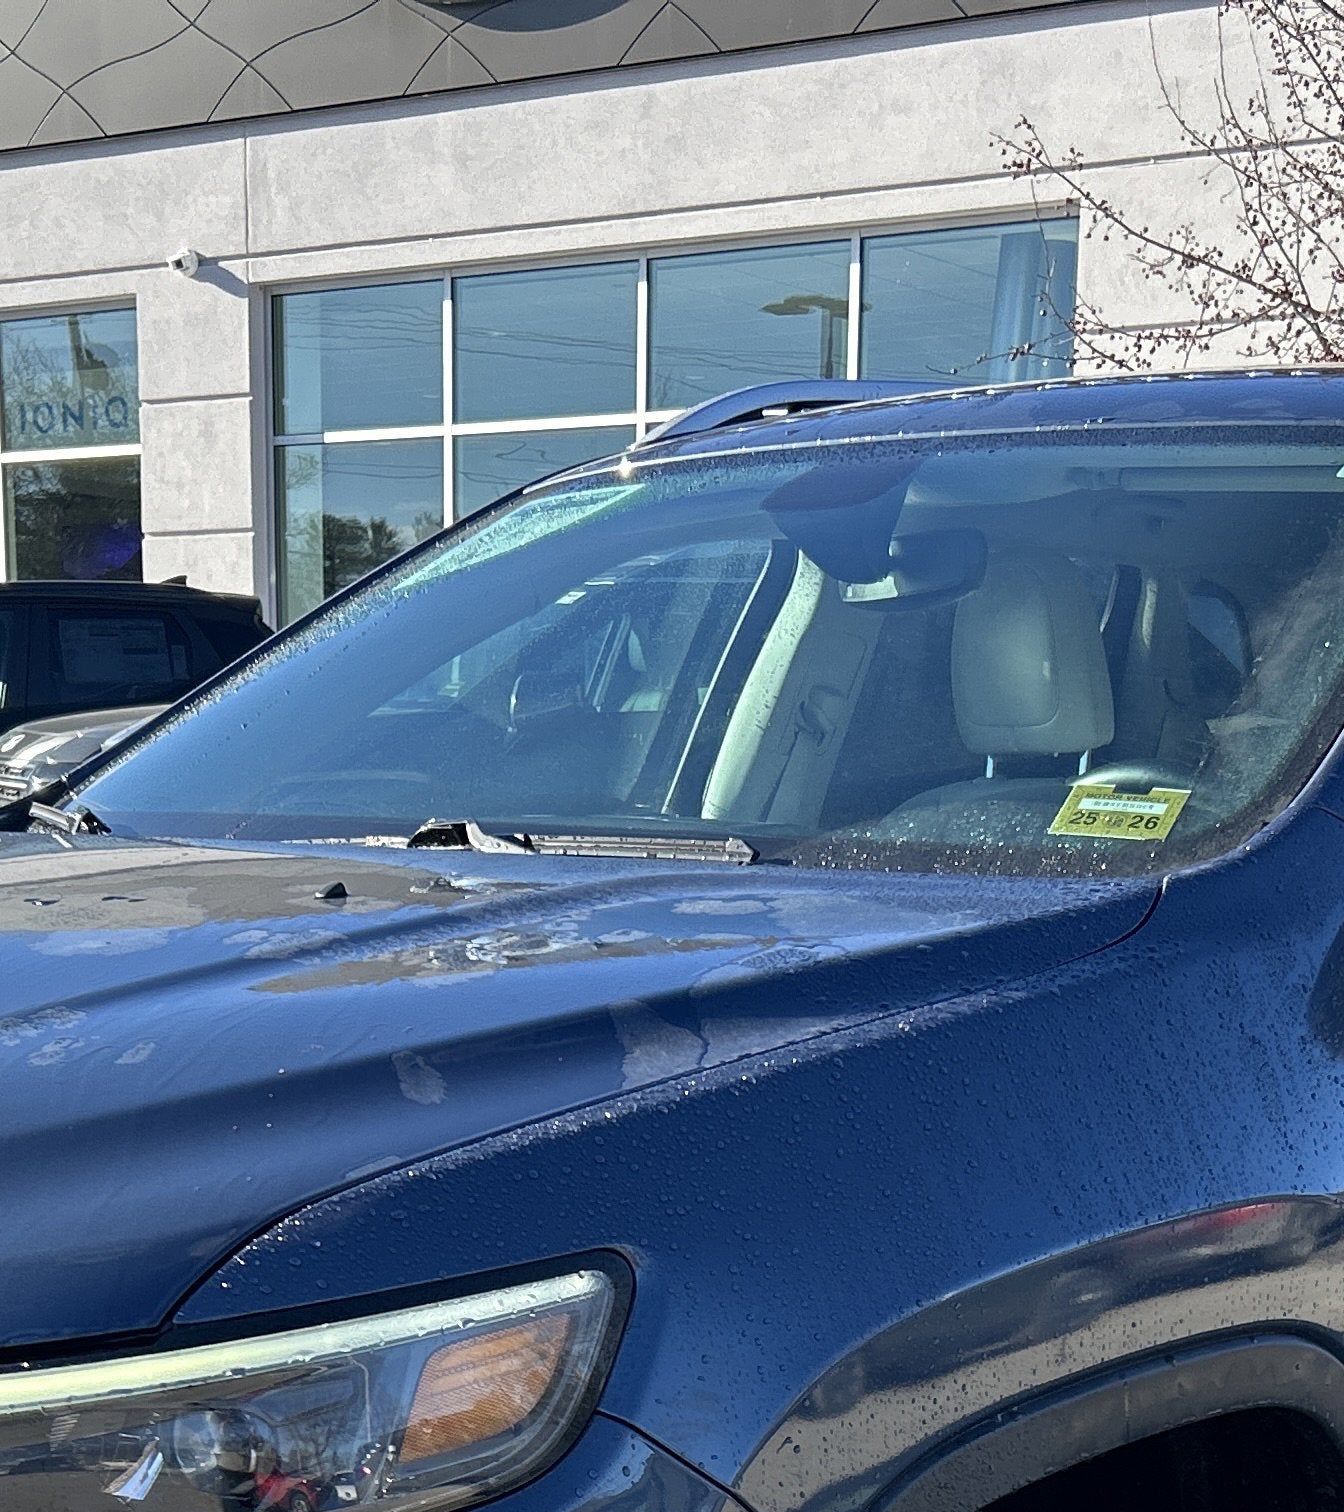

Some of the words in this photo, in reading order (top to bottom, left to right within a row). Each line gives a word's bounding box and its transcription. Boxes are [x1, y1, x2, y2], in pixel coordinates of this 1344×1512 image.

[18, 396, 129, 434] IONIQ
[1067, 811, 1100, 826] 25
[1128, 815, 1160, 830] 26
